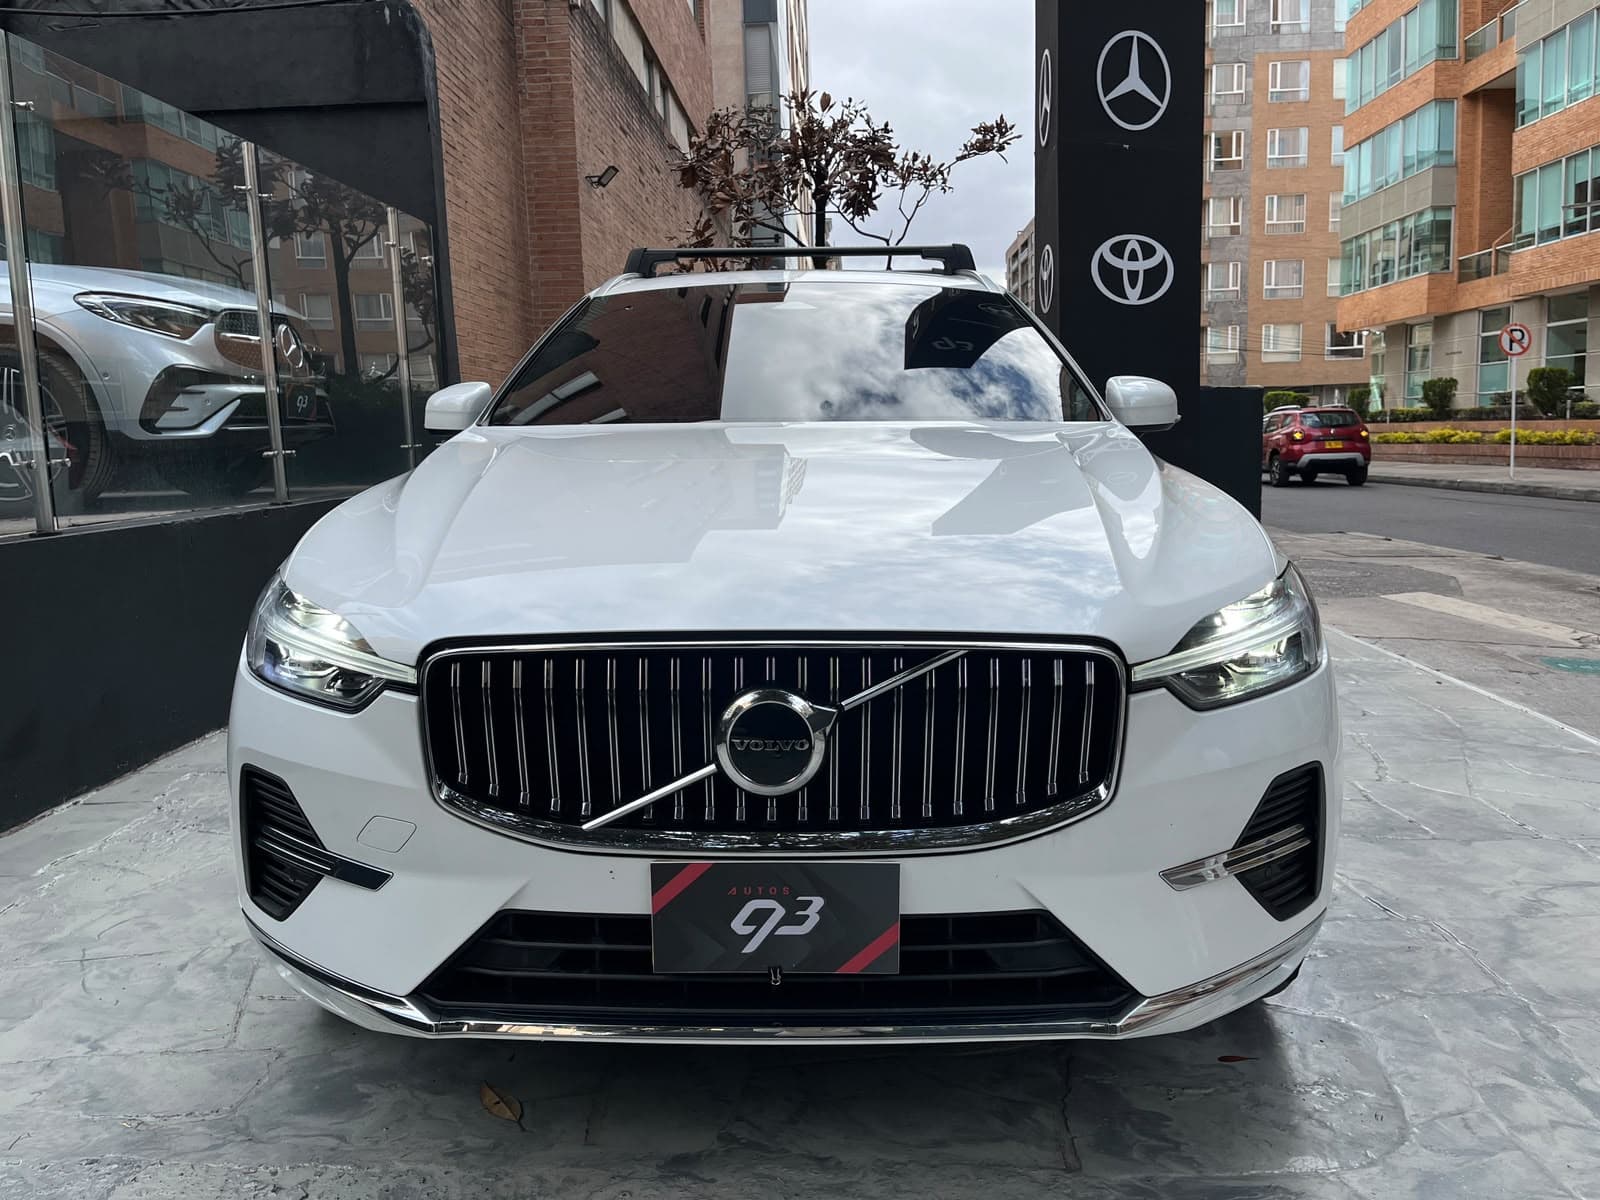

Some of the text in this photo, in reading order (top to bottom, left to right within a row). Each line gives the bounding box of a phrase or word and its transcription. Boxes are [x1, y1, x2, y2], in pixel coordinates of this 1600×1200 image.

[1509, 328, 1525, 351] P
[731, 739, 810, 751] VOLVO
[727, 886, 792, 896] AUTOS
[730, 896, 825, 954] 93
